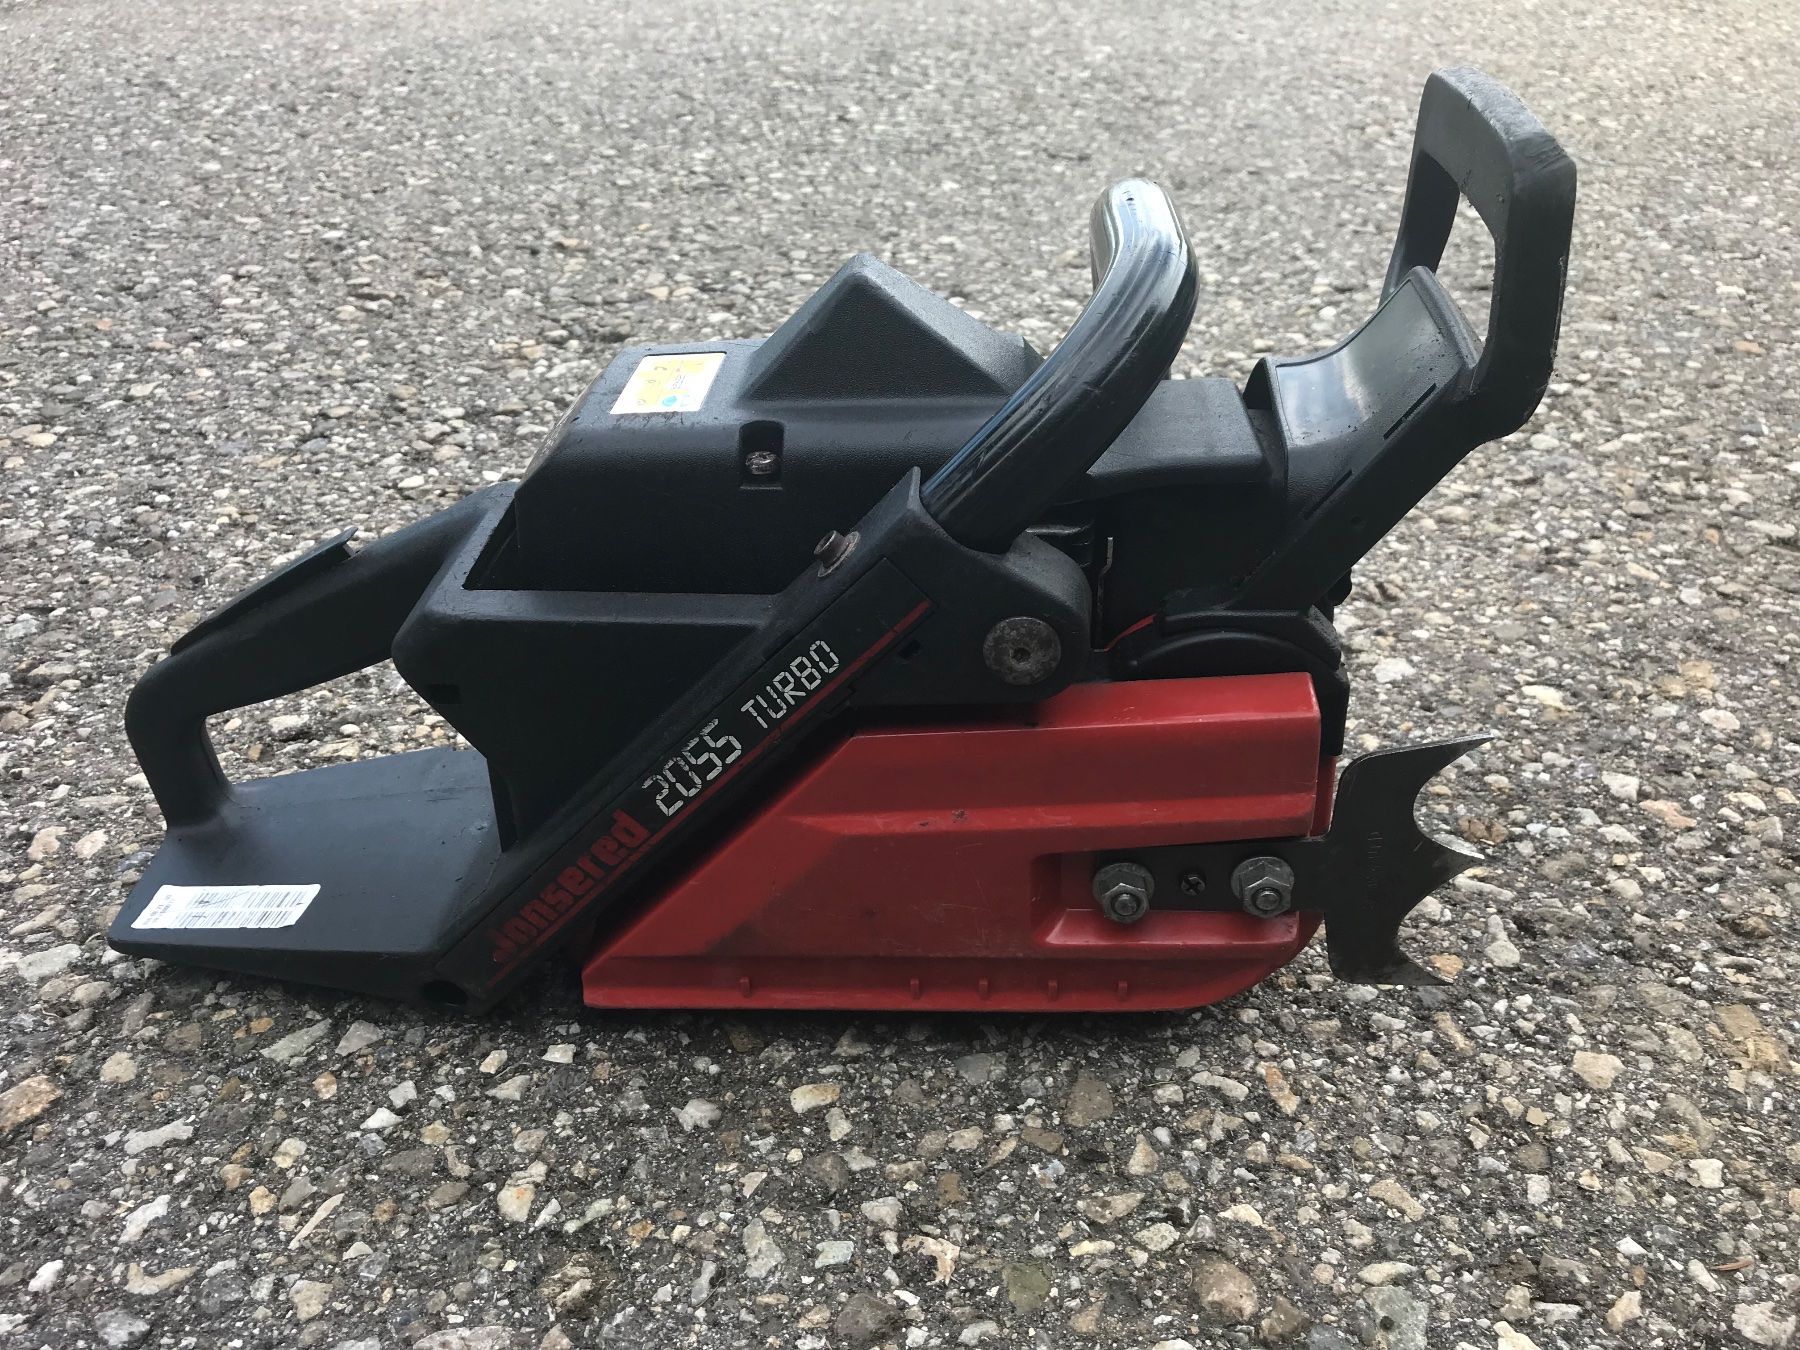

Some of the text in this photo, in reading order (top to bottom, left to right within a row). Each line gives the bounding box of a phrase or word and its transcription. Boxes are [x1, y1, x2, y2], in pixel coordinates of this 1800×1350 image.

[491, 640, 840, 962] Jonsered 2055 TURBO
